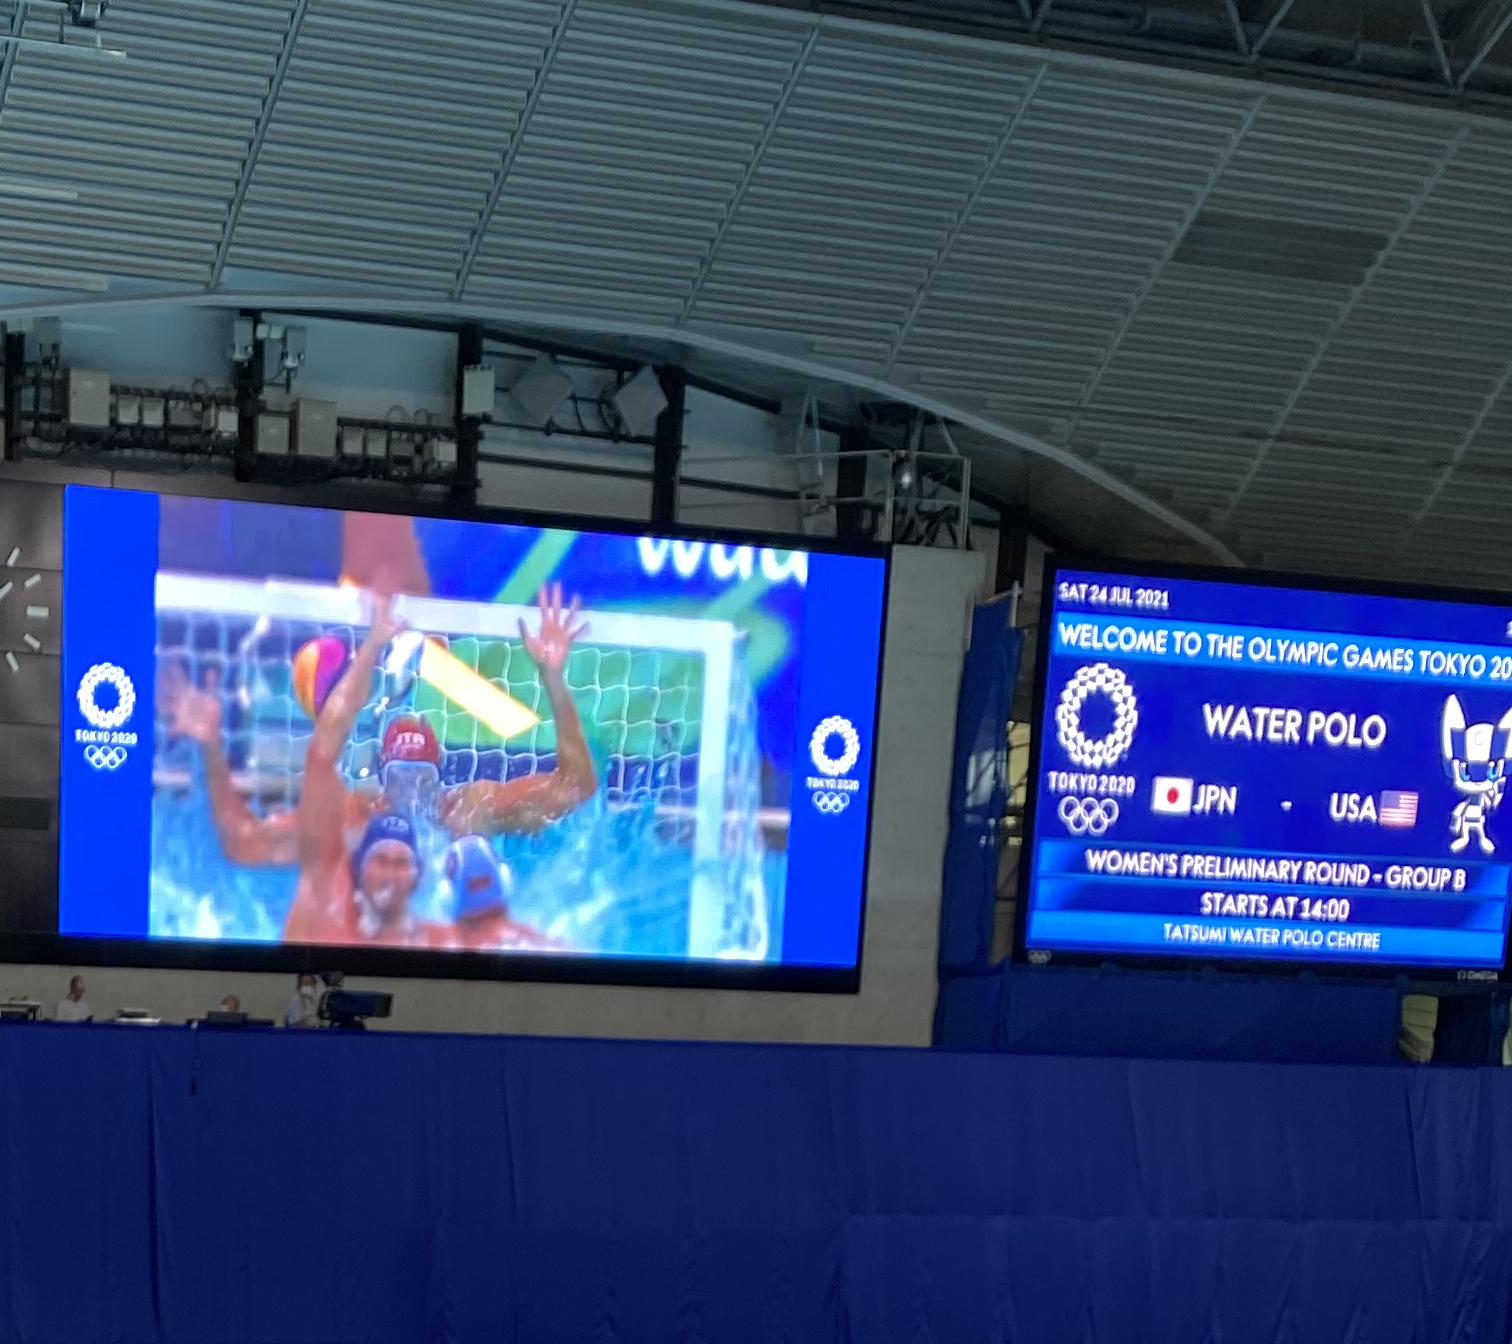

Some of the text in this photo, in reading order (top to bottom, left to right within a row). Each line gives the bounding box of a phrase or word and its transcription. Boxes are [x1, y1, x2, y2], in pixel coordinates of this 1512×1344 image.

[1059, 582, 1170, 609] SAT 24 JUL 2021
[1058, 622, 1169, 653] WELCOME
[1172, 631, 1202, 655] TO
[1206, 633, 1245, 659] THE
[1248, 636, 1339, 667] OLYMPIC
[1342, 645, 1415, 672] GAMES
[1419, 650, 1486, 677] TOKYO
[75, 728, 138, 745] TOKYO 2020
[1201, 703, 1387, 748] WATER POLO
[1047, 771, 1136, 796] TOKYO 2020
[1192, 784, 1237, 814] JPN
[1329, 792, 1377, 823] USA
[1084, 849, 1178, 877] WOMEN'S
[1180, 854, 1302, 883] PRELIMINARY
[1303, 861, 1370, 887] ROUND
[1385, 865, 1452, 891] GROUP
[1452, 868, 1466, 891] B
[1200, 891, 1350, 922] STARTS AT 14:00
[1163, 923, 1381, 950] TATSUMI WATER POLO CENTRE
